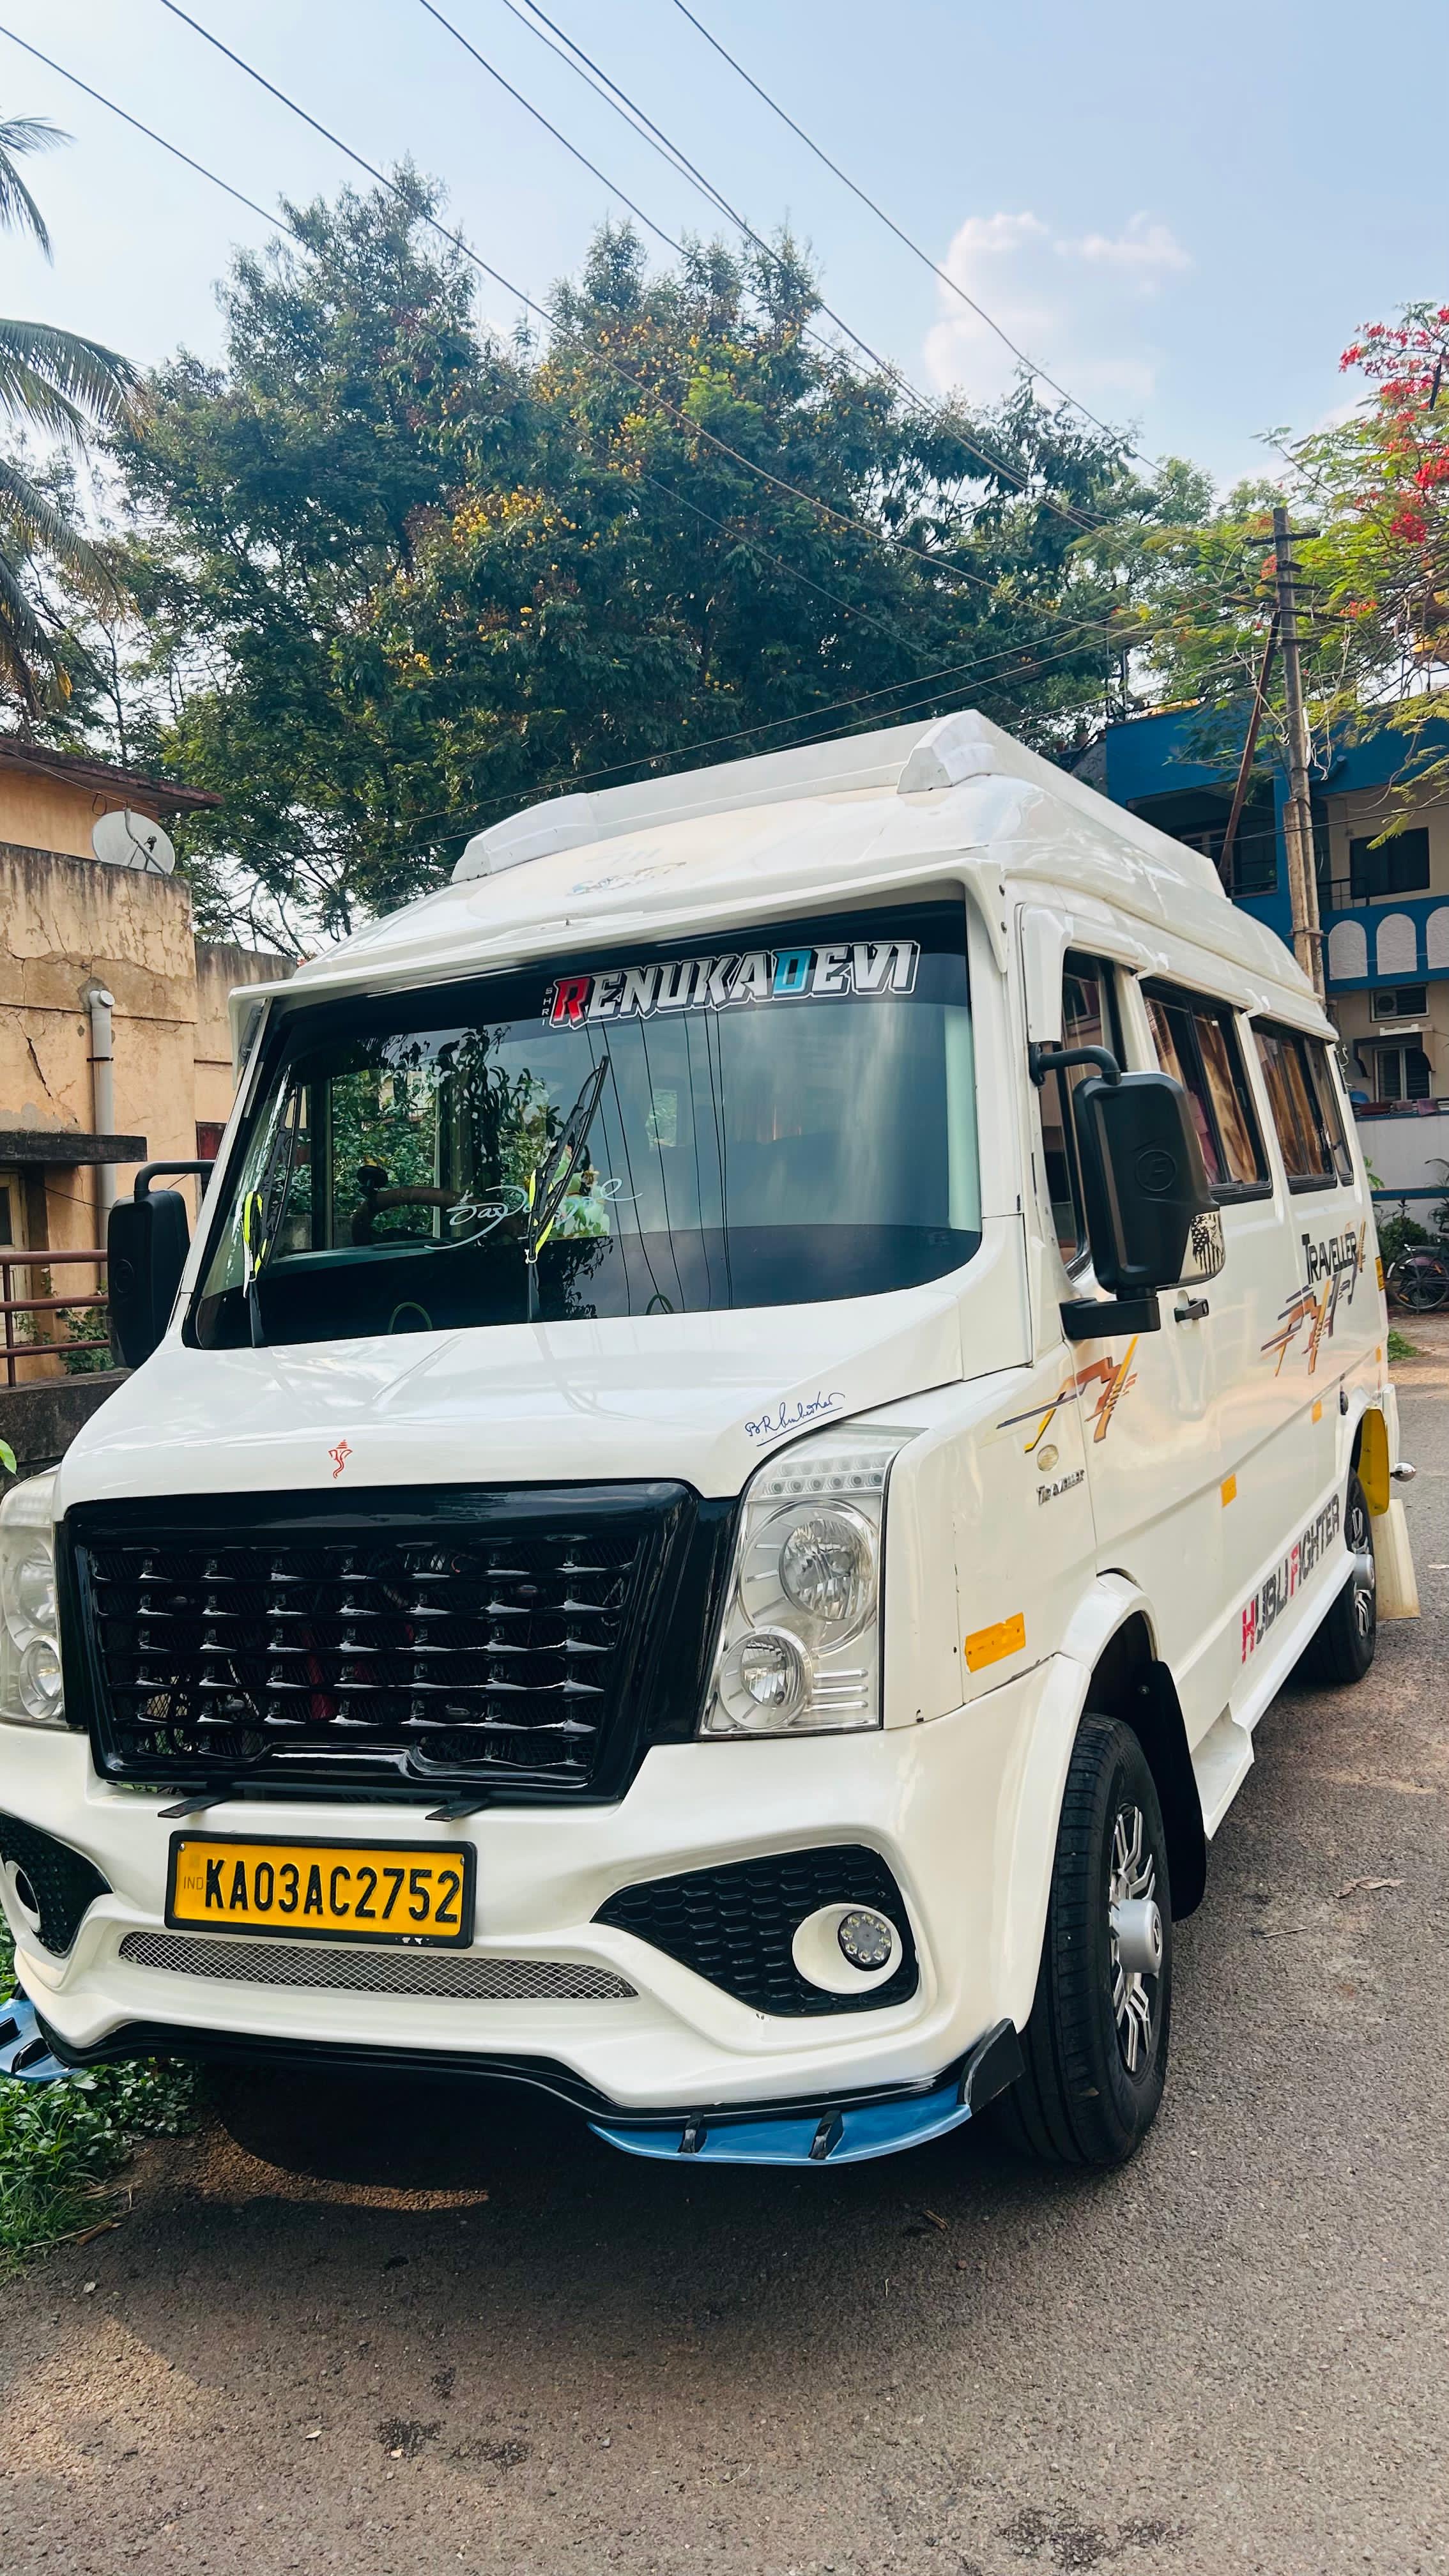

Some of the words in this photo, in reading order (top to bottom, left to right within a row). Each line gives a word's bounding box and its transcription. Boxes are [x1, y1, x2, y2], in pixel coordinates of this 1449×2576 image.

[541, 987, 553, 1027] SHRI
[549, 940, 920, 1030] RENUKADEVI
[1301, 1231, 1356, 1287] TRAVELLER
[183, 1876, 204, 1890] IND
[205, 1859, 461, 1923] KA03AC2752
